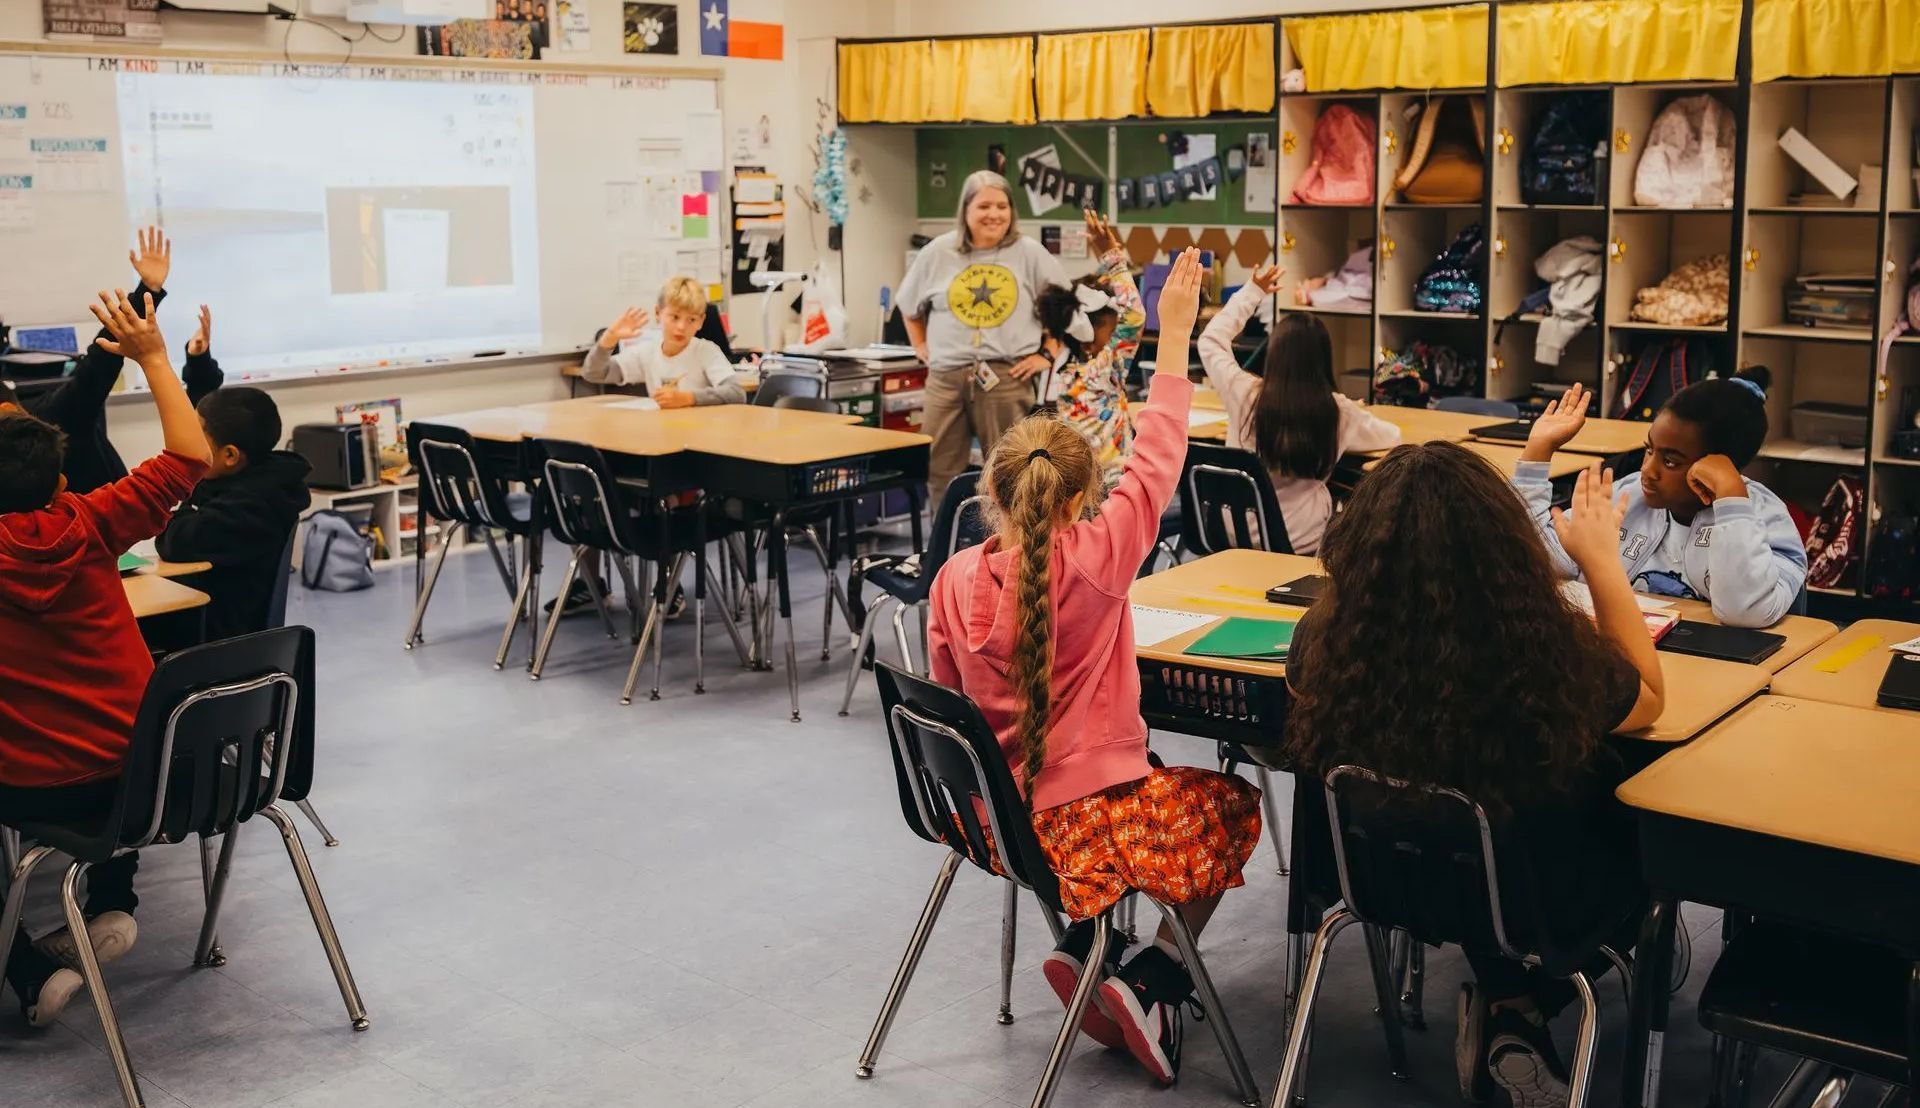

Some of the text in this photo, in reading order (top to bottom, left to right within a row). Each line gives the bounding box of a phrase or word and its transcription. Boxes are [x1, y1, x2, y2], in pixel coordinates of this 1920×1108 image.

[81, 22, 123, 35] OTHERS
[98, 58, 118, 71] AM
[124, 58, 160, 73] KIND
[185, 61, 205, 74] AM
[282, 64, 299, 77] AM
[369, 67, 386, 80] AM
[460, 70, 475, 82] AM
[528, 72, 542, 85] AM
[620, 77, 633, 89] AM
